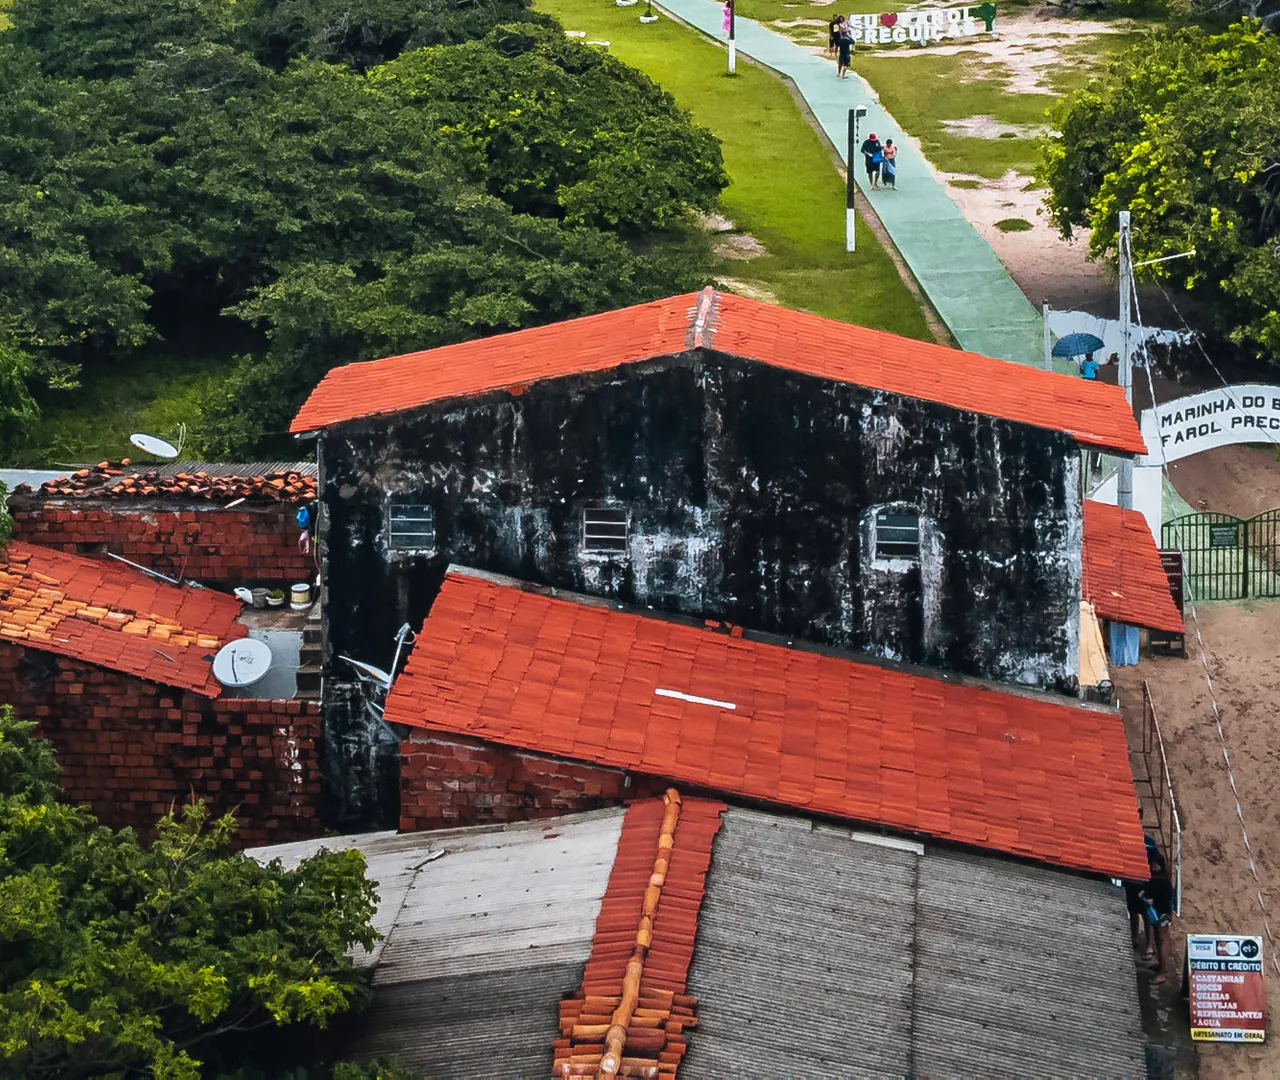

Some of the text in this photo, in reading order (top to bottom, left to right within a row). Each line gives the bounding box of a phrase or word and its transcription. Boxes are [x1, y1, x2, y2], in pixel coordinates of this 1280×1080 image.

[849, 8, 975, 30] EU FAROL
[851, 22, 975, 43] PREGUIÇAS
[1161, 398, 1235, 428] MARINHA
[1242, 395, 1265, 409] DO
[1161, 421, 1222, 448] FAROL
[1192, 961, 1261, 971] DÉBITO E CRÉDITO
[1196, 974, 1245, 983] CASTANHAS
[1196, 992, 1230, 1000] GELEIAS
[1197, 1001, 1238, 1009] CERVEJAS
[1197, 1010, 1263, 1019] REFRIGERANTES
[1197, 1018, 1221, 1027] ÁGUA
[1193, 1030, 1263, 1040] ARTESANATO EM GERAL
